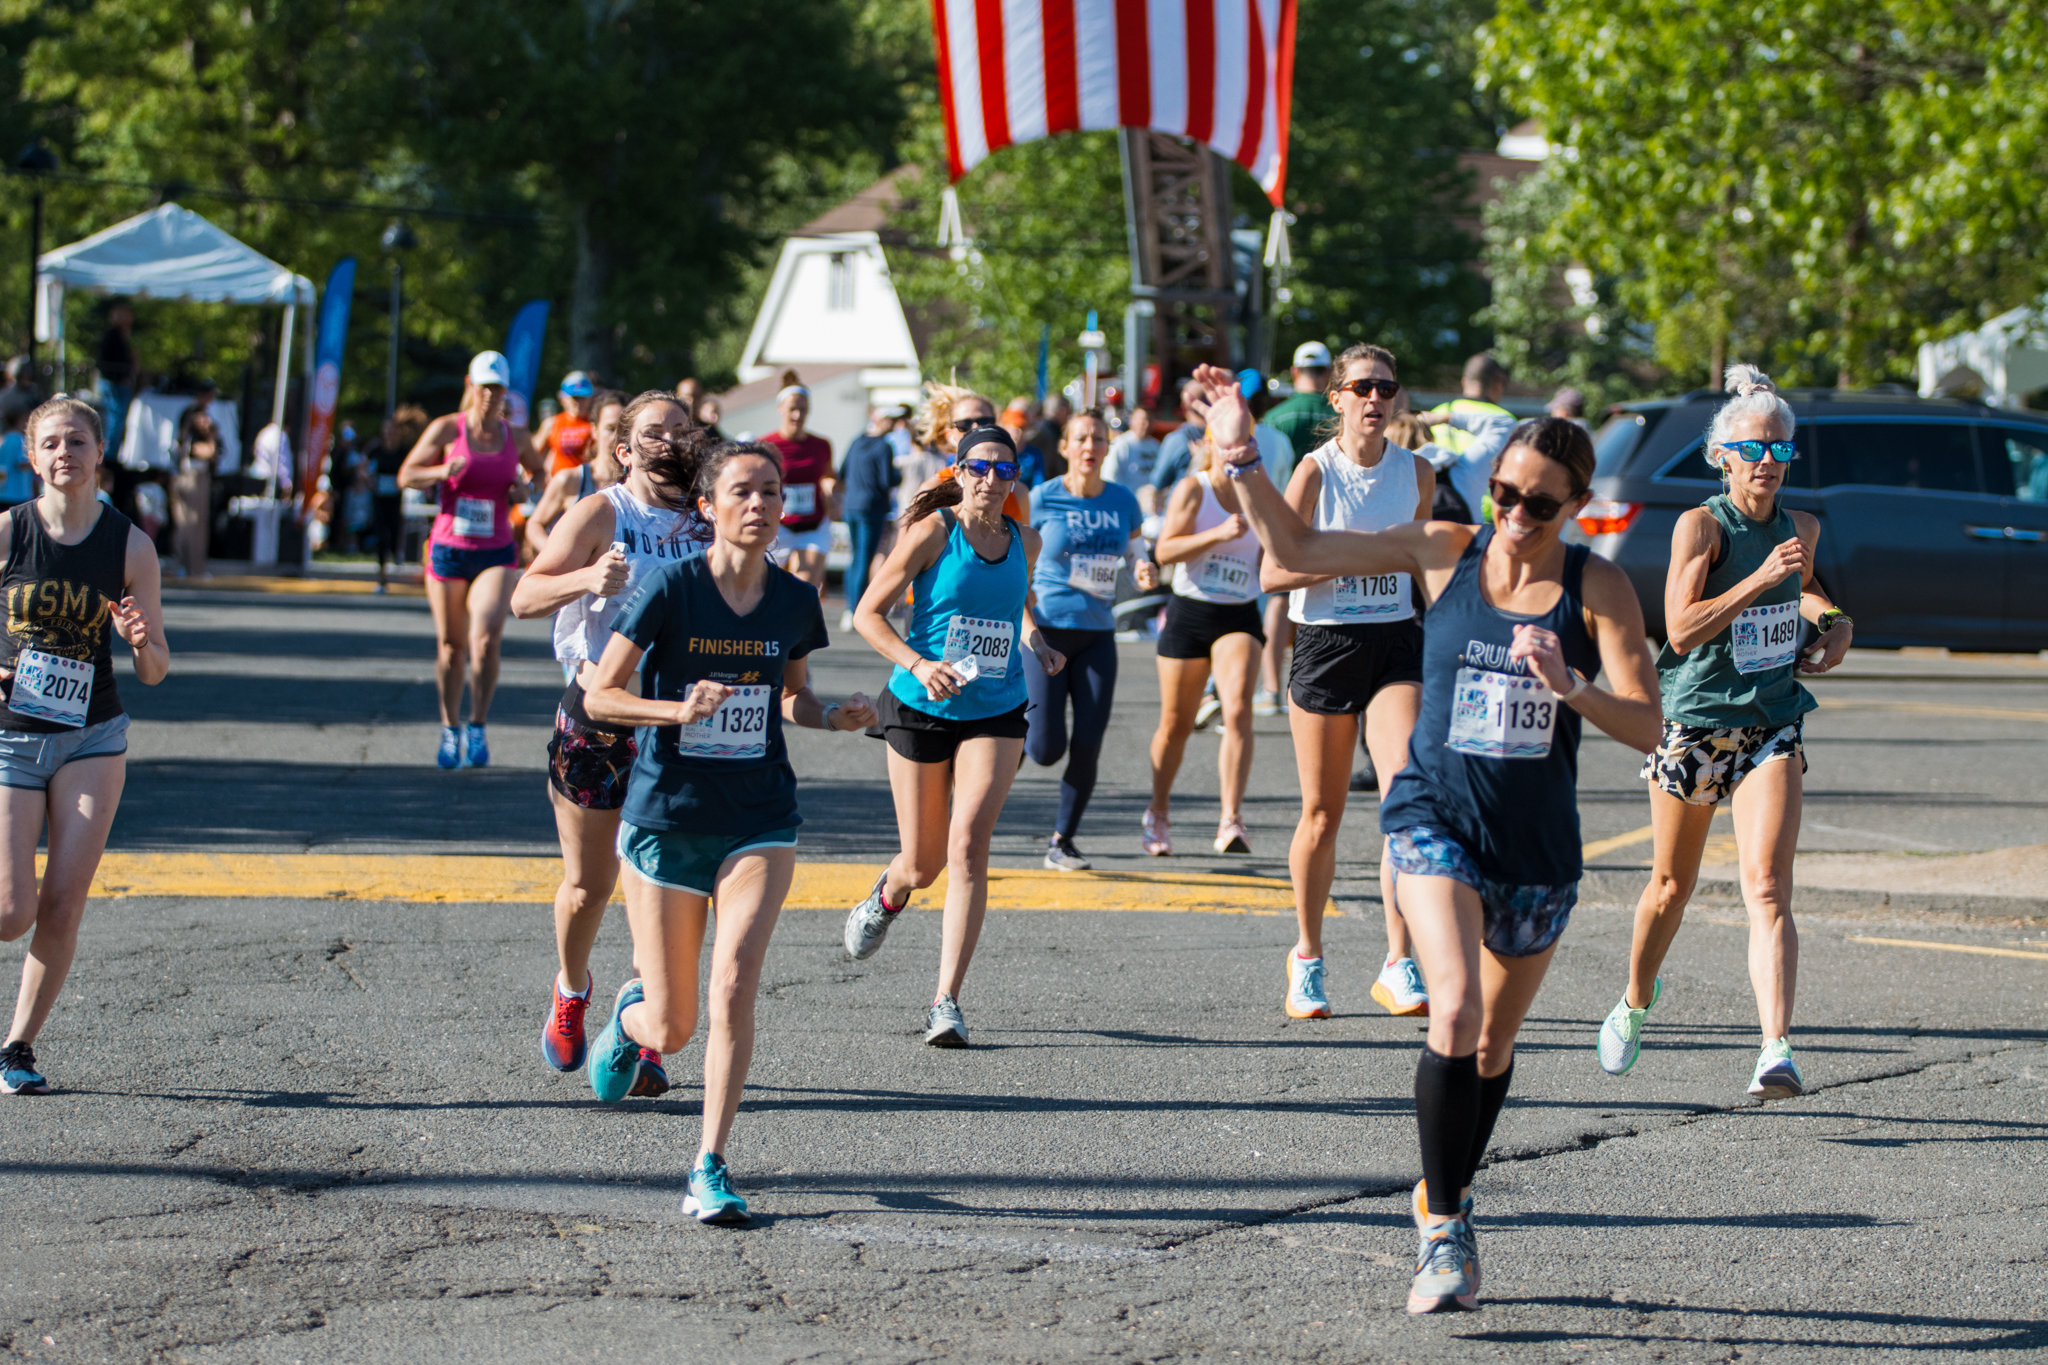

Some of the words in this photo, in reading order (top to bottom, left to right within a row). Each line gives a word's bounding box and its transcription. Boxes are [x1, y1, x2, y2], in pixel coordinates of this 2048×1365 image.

[1066, 509, 1120, 530] RUN
[1091, 567, 1115, 583] 1664
[1222, 567, 1249, 587] 1477
[1360, 574, 1398, 597] 1703
[6, 578, 112, 644] USMA
[971, 634, 1010, 658] 2083
[1762, 619, 1795, 648] 1489
[1466, 639, 1528, 675] RUN
[42, 673, 90, 705] 2074
[720, 705, 766, 733] 1323
[1496, 700, 1553, 730] 1133
